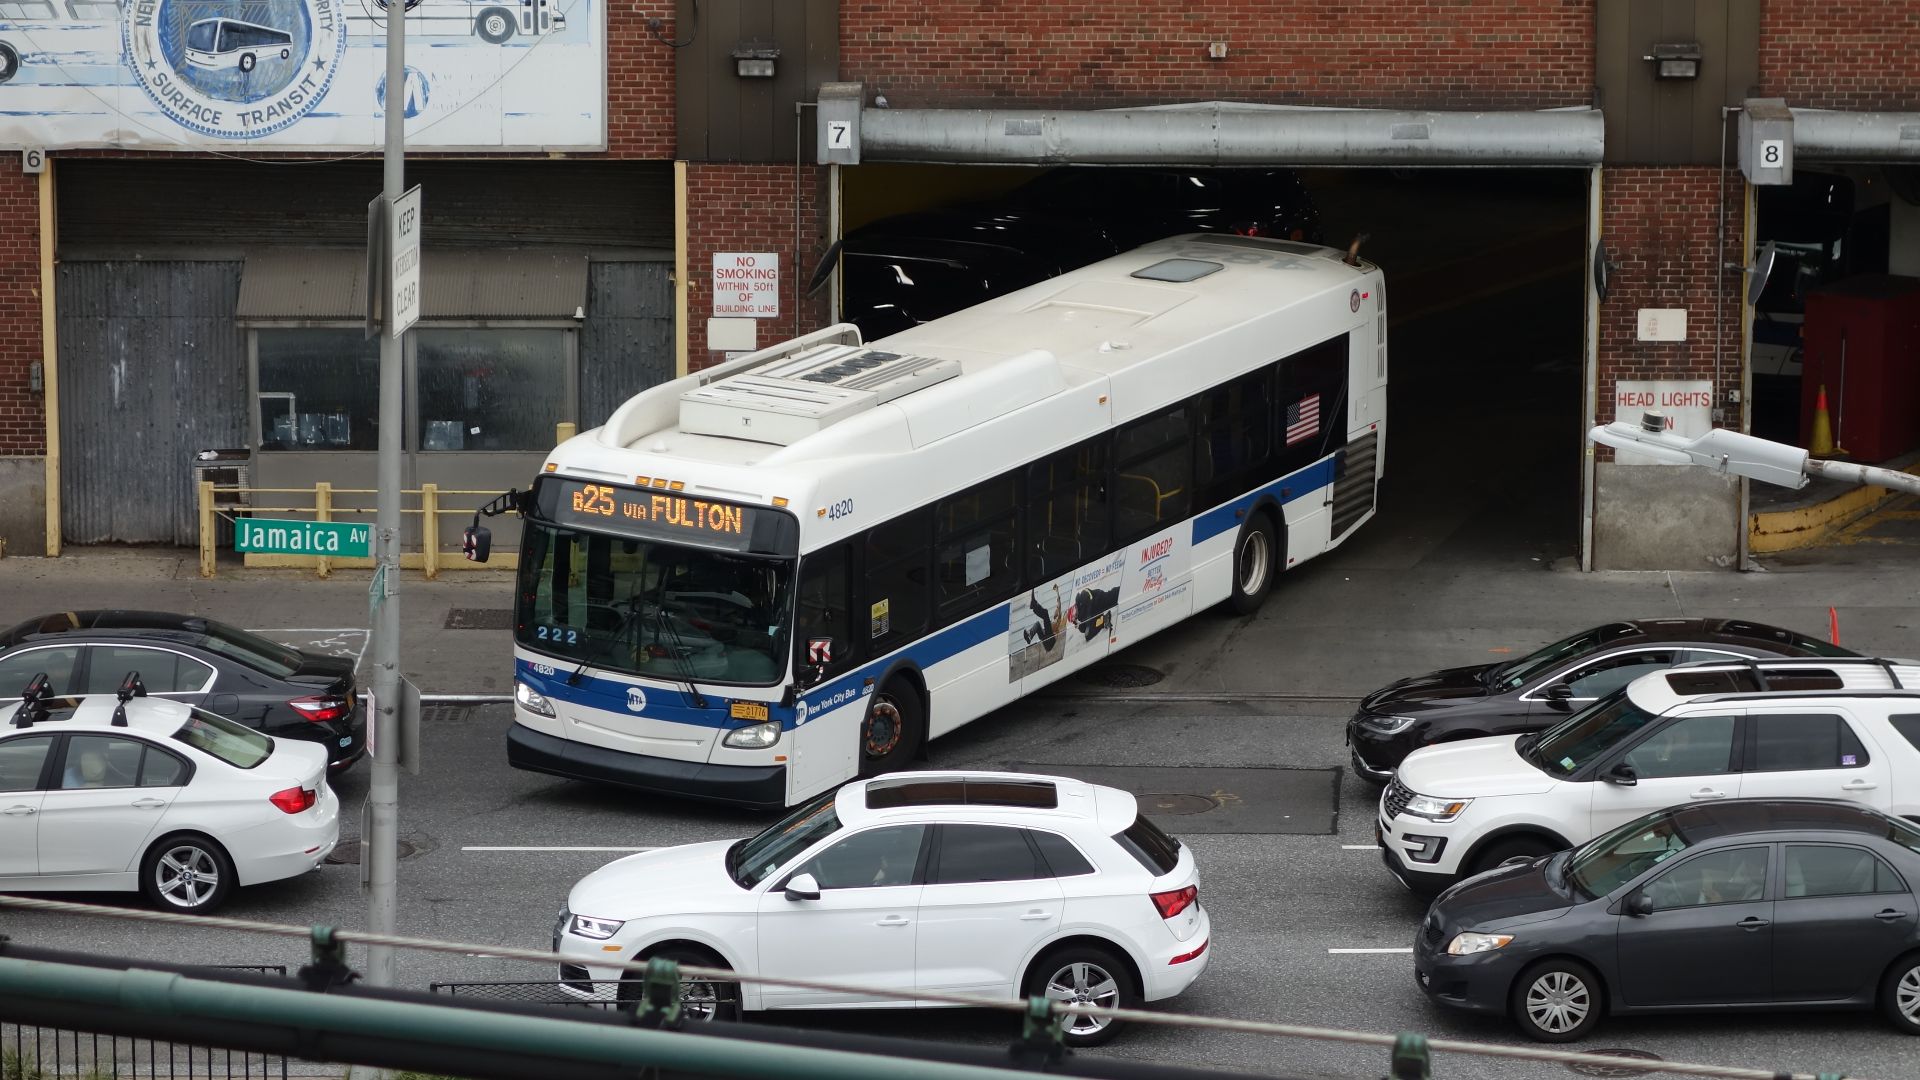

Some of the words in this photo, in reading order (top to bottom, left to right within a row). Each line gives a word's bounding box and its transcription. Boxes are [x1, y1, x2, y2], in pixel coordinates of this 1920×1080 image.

[152, 72, 222, 125] SURFACE
[237, 73, 316, 127] TRANSIT
[833, 126, 846, 143] 7
[27, 151, 40, 167] 6
[1765, 145, 1778, 162] 8
[398, 206, 415, 239] KEEP
[736, 256, 755, 267] NO
[716, 268, 776, 279] SMOKING
[716, 282, 749, 291] WITHIN
[754, 282, 773, 291] 50ft
[396, 281, 416, 317] CLEAR
[739, 292, 753, 302] OF
[716, 304, 754, 313] BUILDING
[758, 304, 776, 313] LINE
[1618, 392, 1655, 407] HEAD
[1662, 392, 1710, 407] LIGHTS
[573, 484, 615, 516] B25
[623, 502, 647, 520] VIA
[651, 495, 742, 534] FULTON
[828, 498, 853, 521] 4820
[240, 523, 339, 551] Jamaica
[350, 527, 367, 543] Av
[1141, 537, 1173, 563] INJURED?
[533, 663, 555, 676] 4820
[627, 693, 643, 705] MTA
[808, 704, 820, 716] New
[820, 698, 833, 710] York
[833, 692, 845, 704] City
[845, 688, 856, 699] Bus
